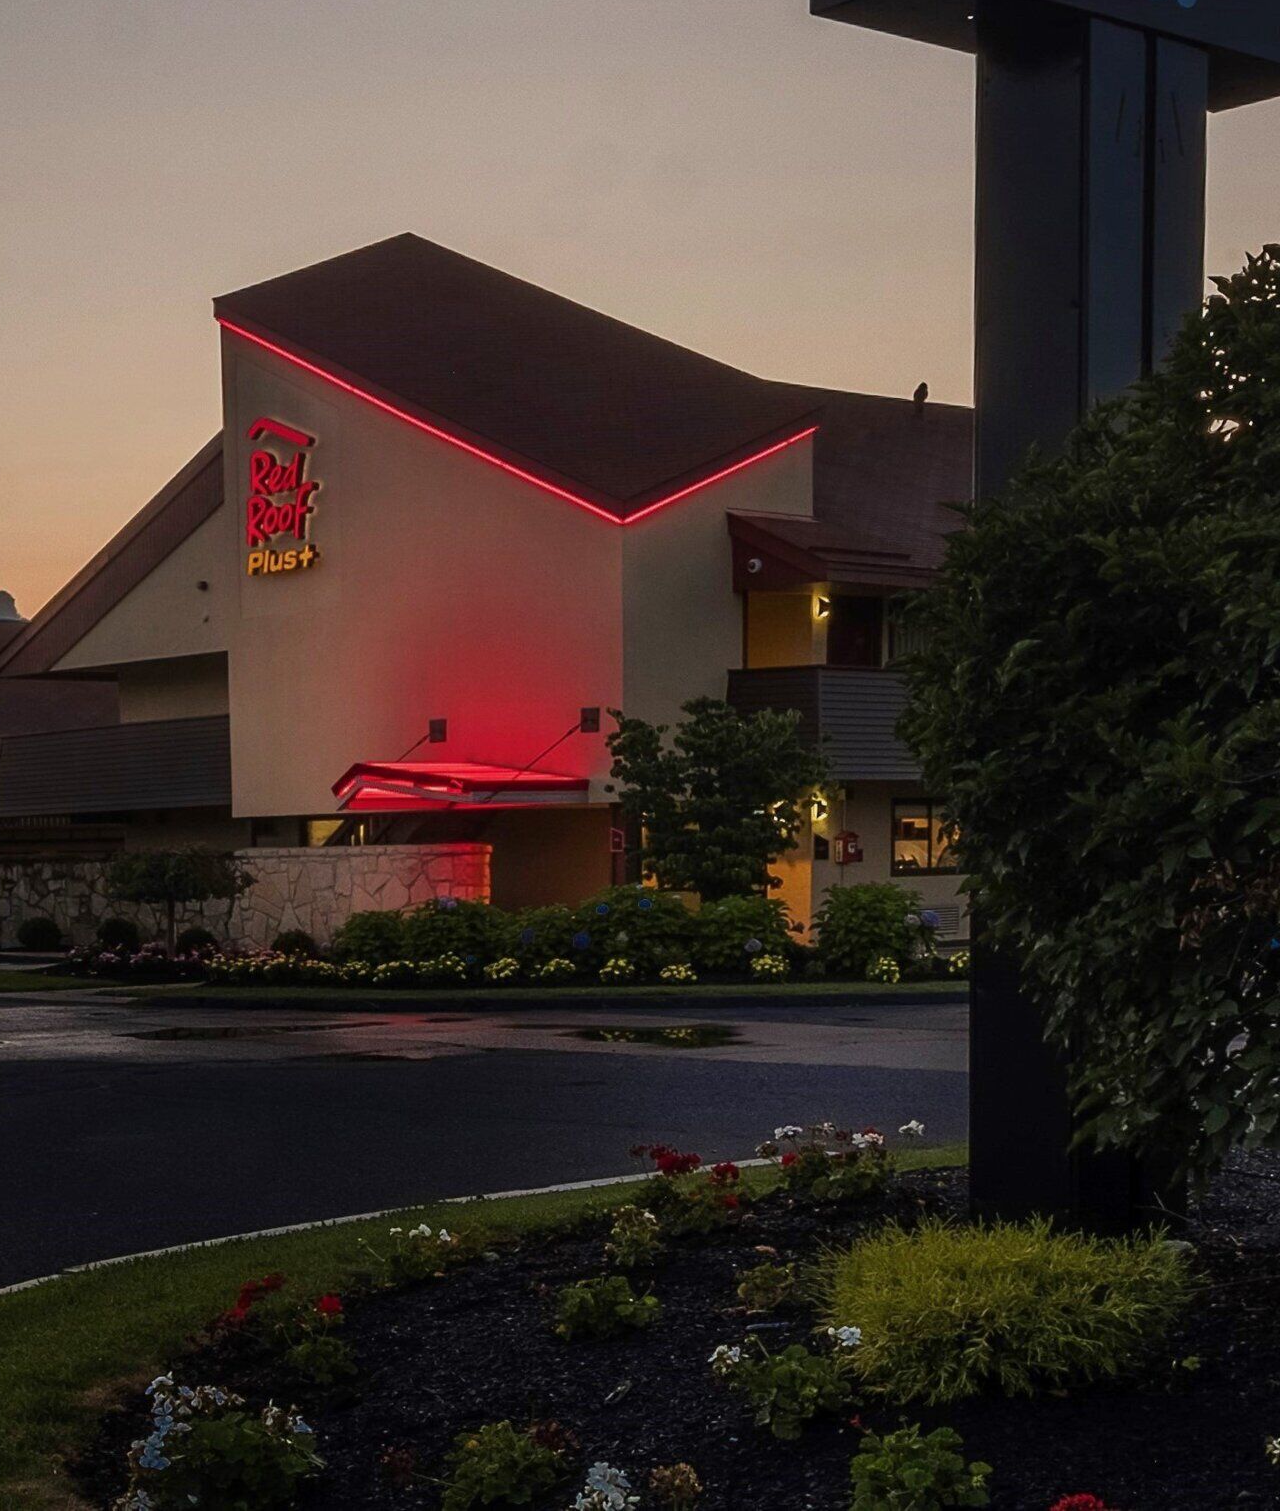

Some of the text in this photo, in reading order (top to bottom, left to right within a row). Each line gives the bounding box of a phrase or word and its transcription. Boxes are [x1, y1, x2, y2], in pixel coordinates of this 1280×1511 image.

[250, 450, 306, 494] Red
[247, 481, 319, 547] Roof
[247, 543, 317, 577] Plus+
